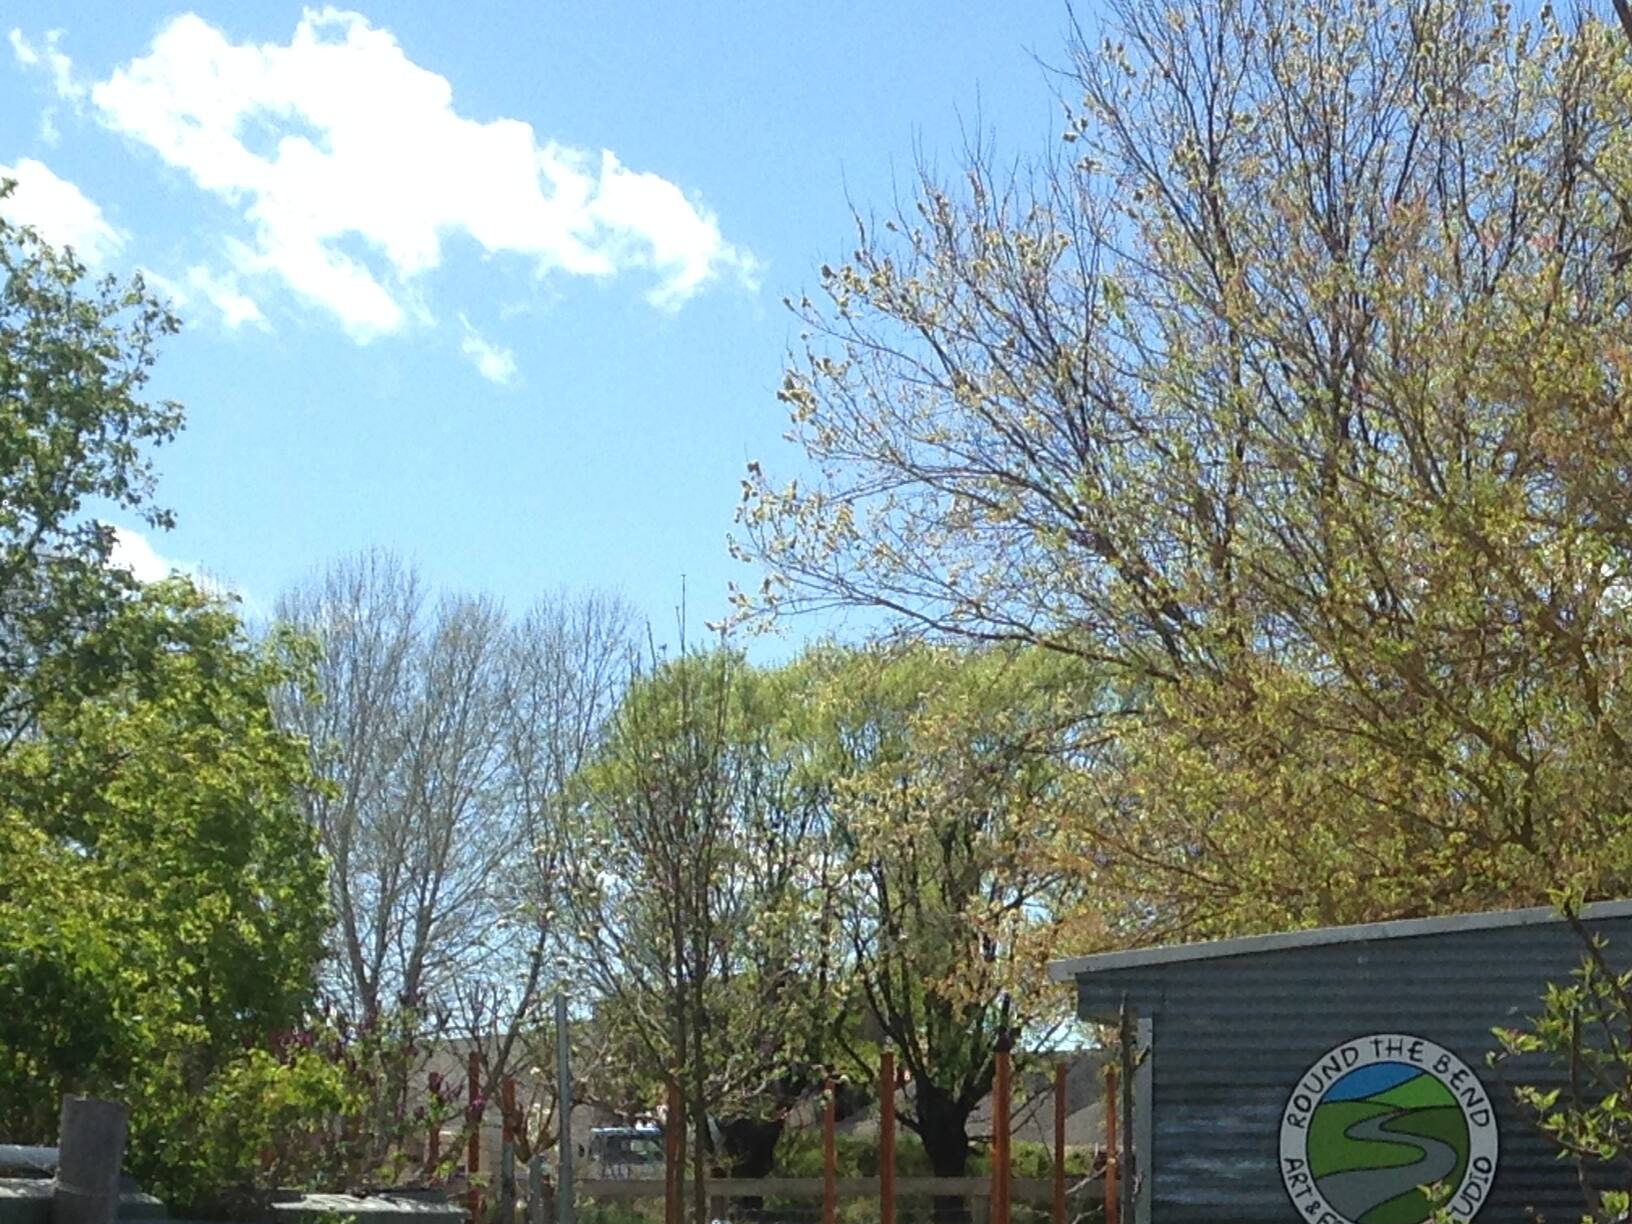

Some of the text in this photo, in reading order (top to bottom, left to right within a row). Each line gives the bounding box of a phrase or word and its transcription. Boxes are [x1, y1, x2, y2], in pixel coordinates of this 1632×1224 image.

[1287, 1037, 1490, 1128] ROUND THE BEND
[1283, 1157, 1314, 1198] ART
[1305, 1200, 1321, 1214] &
